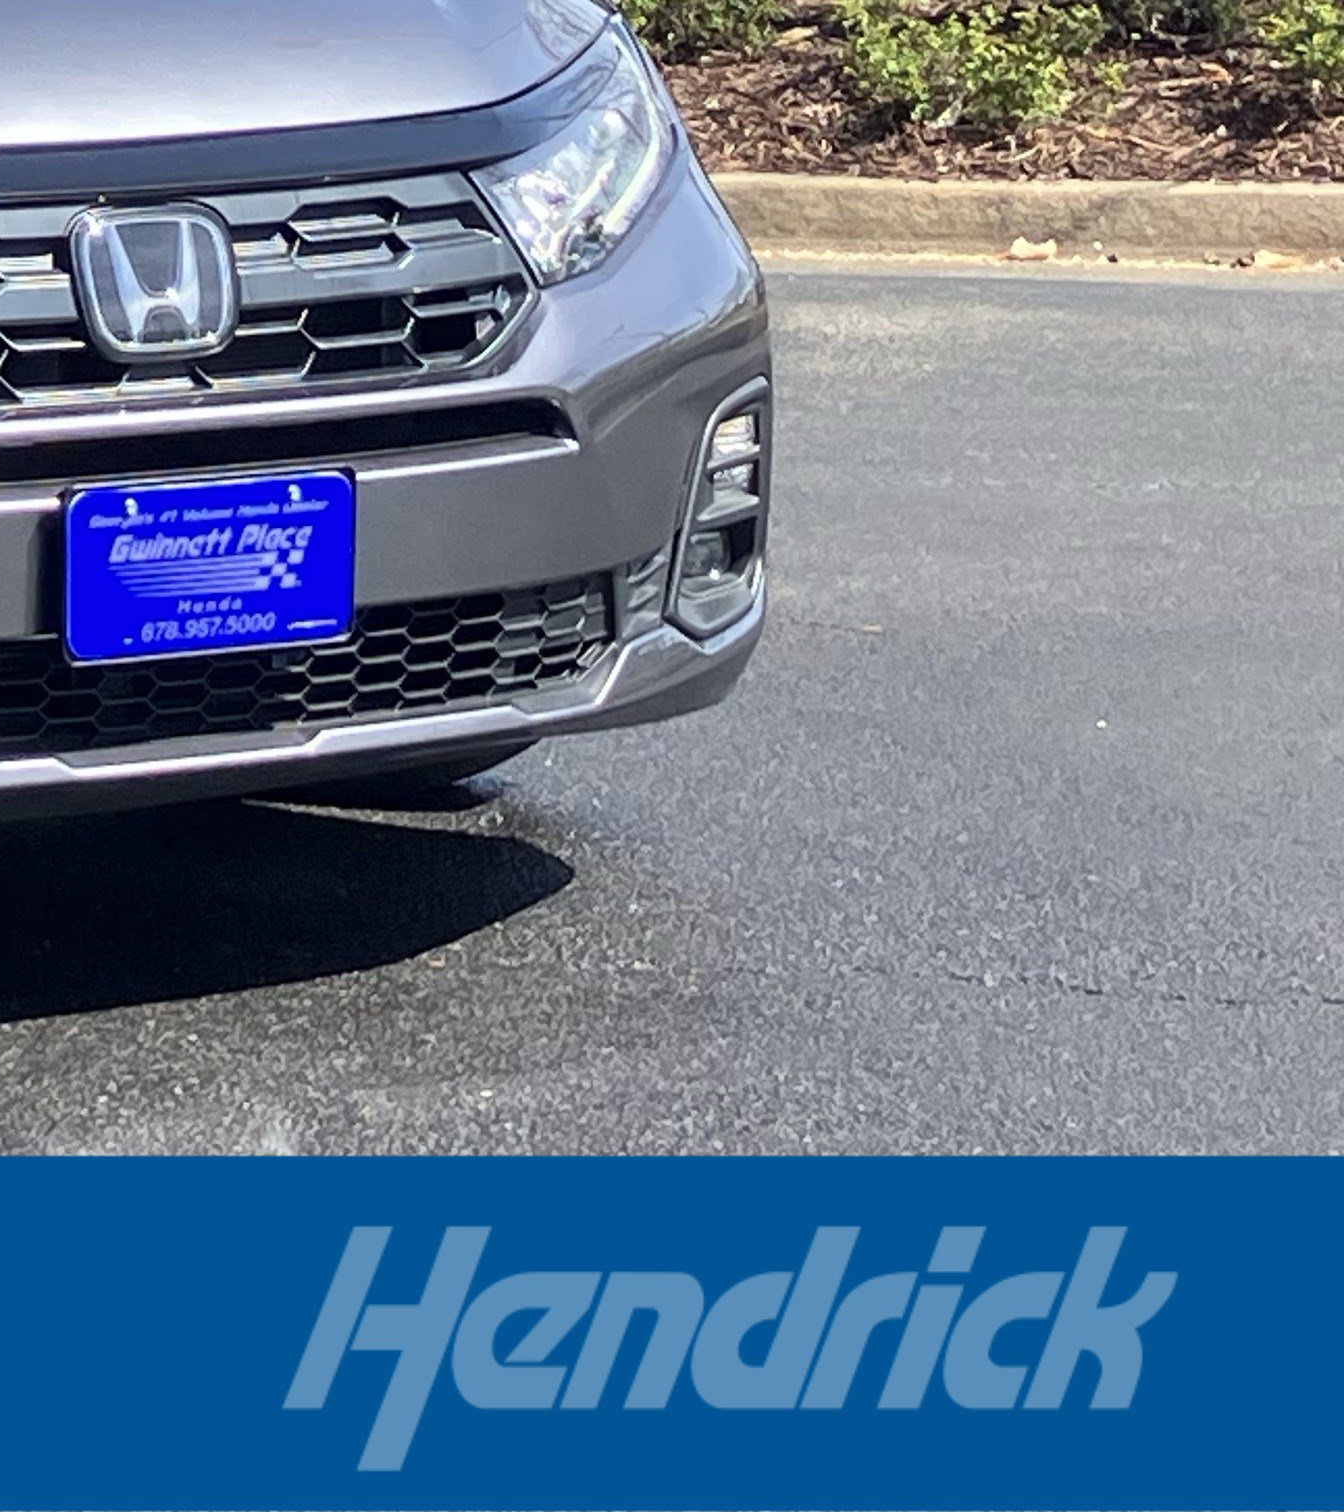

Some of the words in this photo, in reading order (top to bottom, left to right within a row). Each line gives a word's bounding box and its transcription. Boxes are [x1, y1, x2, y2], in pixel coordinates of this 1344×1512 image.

[109, 526, 233, 563] Gwinnett
[237, 523, 313, 552] Place
[176, 595, 243, 615] Honda
[141, 612, 276, 642] 678.957.5000
